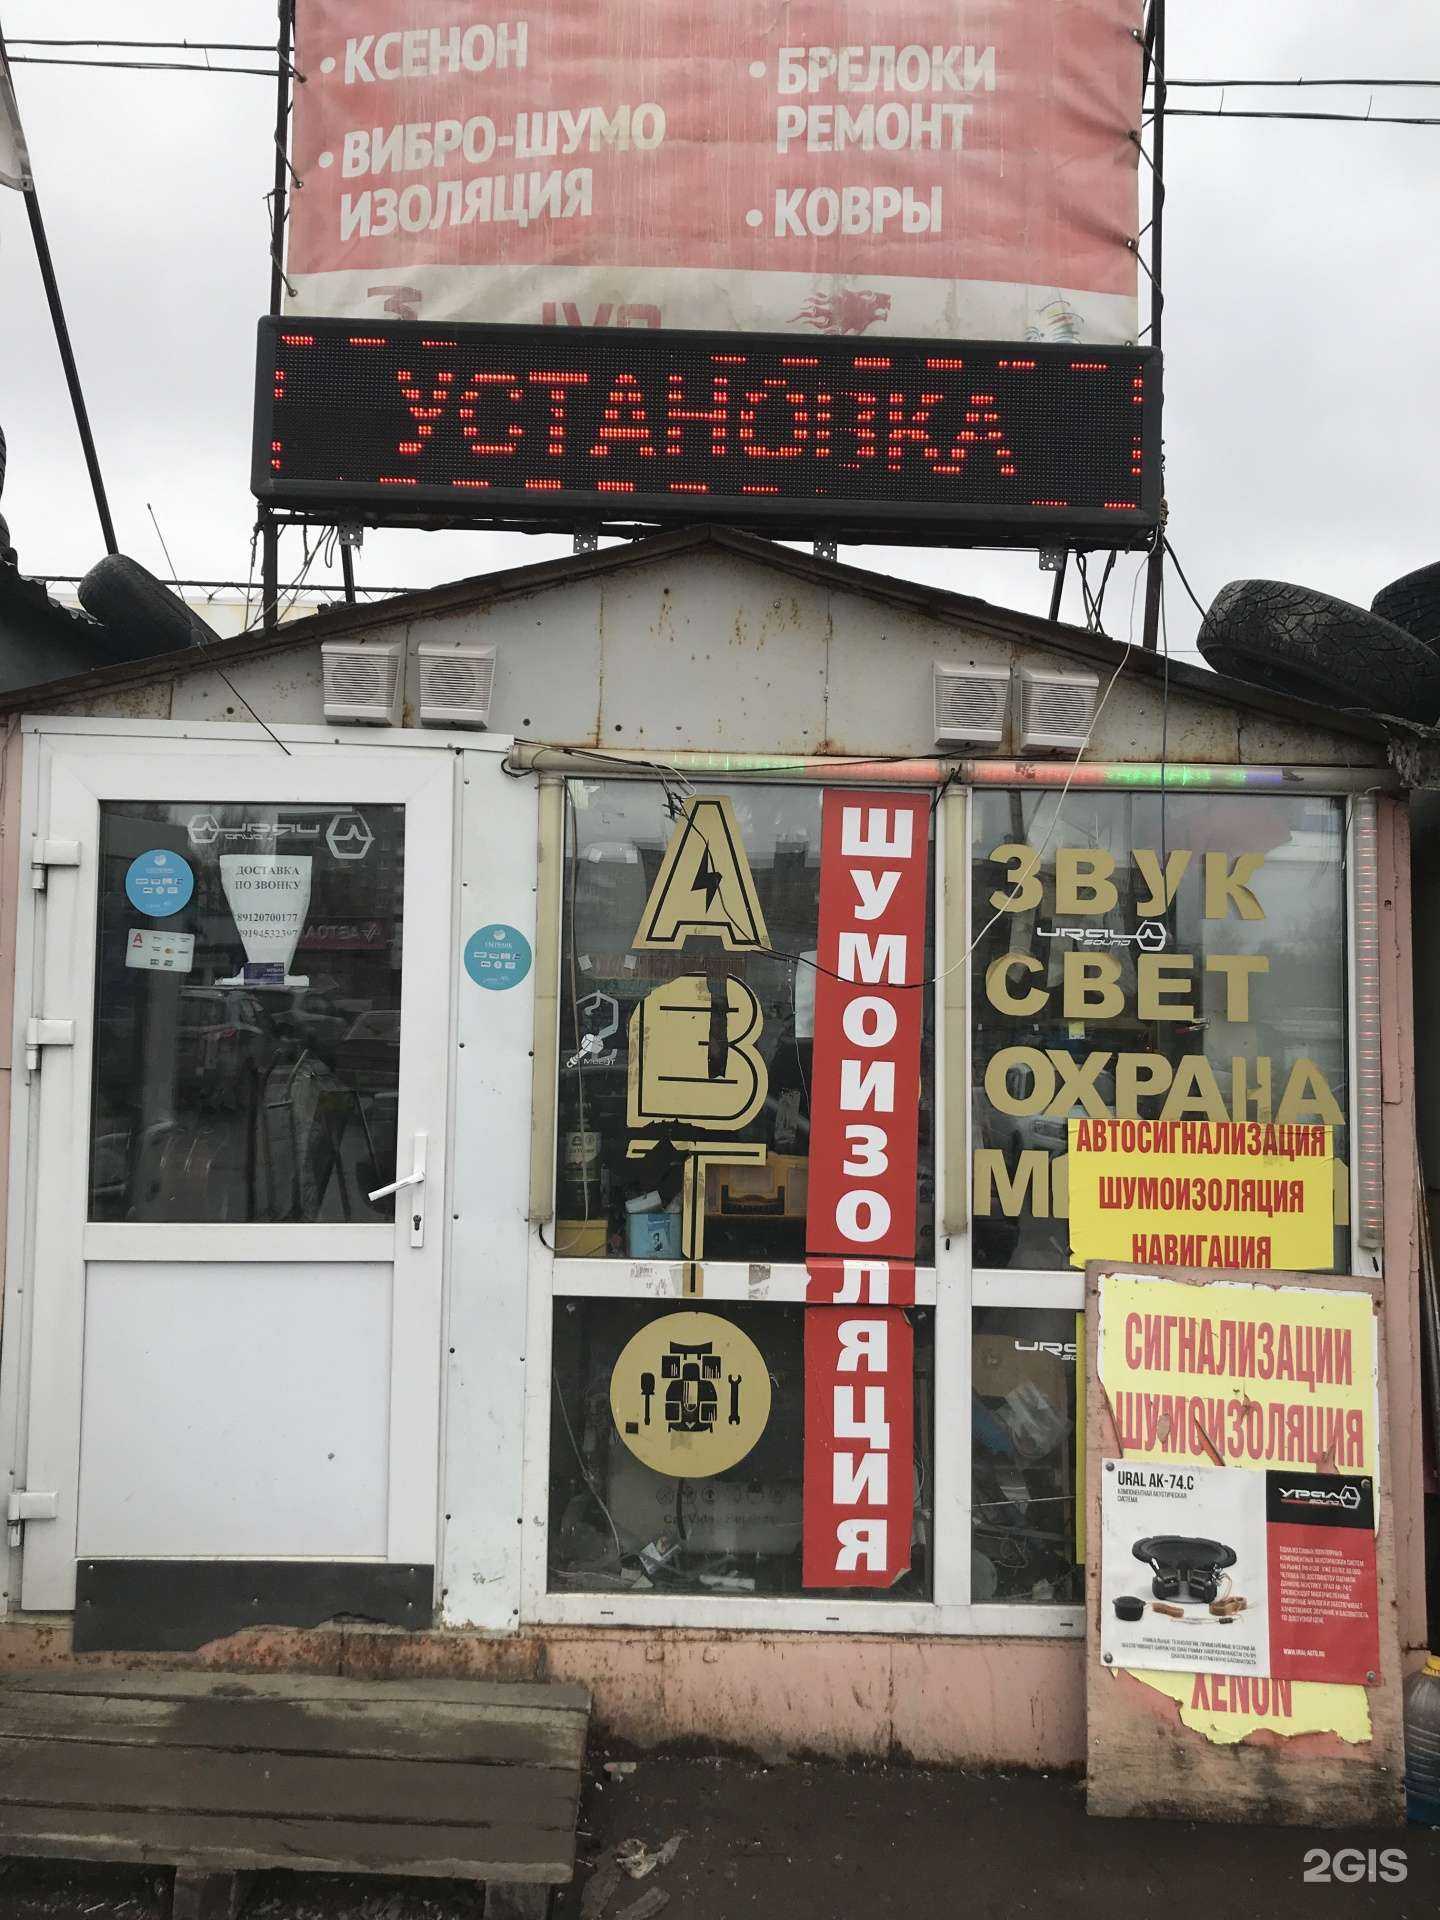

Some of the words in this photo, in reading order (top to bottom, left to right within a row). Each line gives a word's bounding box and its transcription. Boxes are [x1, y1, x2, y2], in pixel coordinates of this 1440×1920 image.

[343, 21, 529, 85] КСЕНОН
[777, 44, 997, 95] БРЕЛОКИ
[341, 102, 667, 179] ВИБРО-ШУМО
[776, 101, 974, 155] РЕМОНТ
[339, 166, 594, 242] ИЗОЛЯЦИЯ
[773, 185, 943, 238] КОВРЫ
[235, 880, 251, 890] ПО
[236, 865, 300, 876] ДОСТАВКА
[253, 880, 302, 890] ЗВОНКУ
[988, 844, 1267, 920] ЗВУК
[986, 951, 1270, 1022] СВЕТ
[984, 1046, 1346, 1125] ОХРАНА
[1076, 1120, 1327, 1161] АВТОСИГНАЛИЗАЦИЯ
[833, 806, 915, 1571] ШУМОИЗОЛЯЦИЯ
[1098, 1175, 1305, 1218] ШУМОИЗОЛЯЦИЯ
[1132, 1233, 1272, 1269] НАВИГАЦИЯ
[1124, 1311, 1353, 1392] СИГНАЛИЗАЦИИ
[1115, 1390, 1364, 1470] ШУМОИЗОЛЯЦИЯ
[1117, 1470, 1147, 1488] URAL
